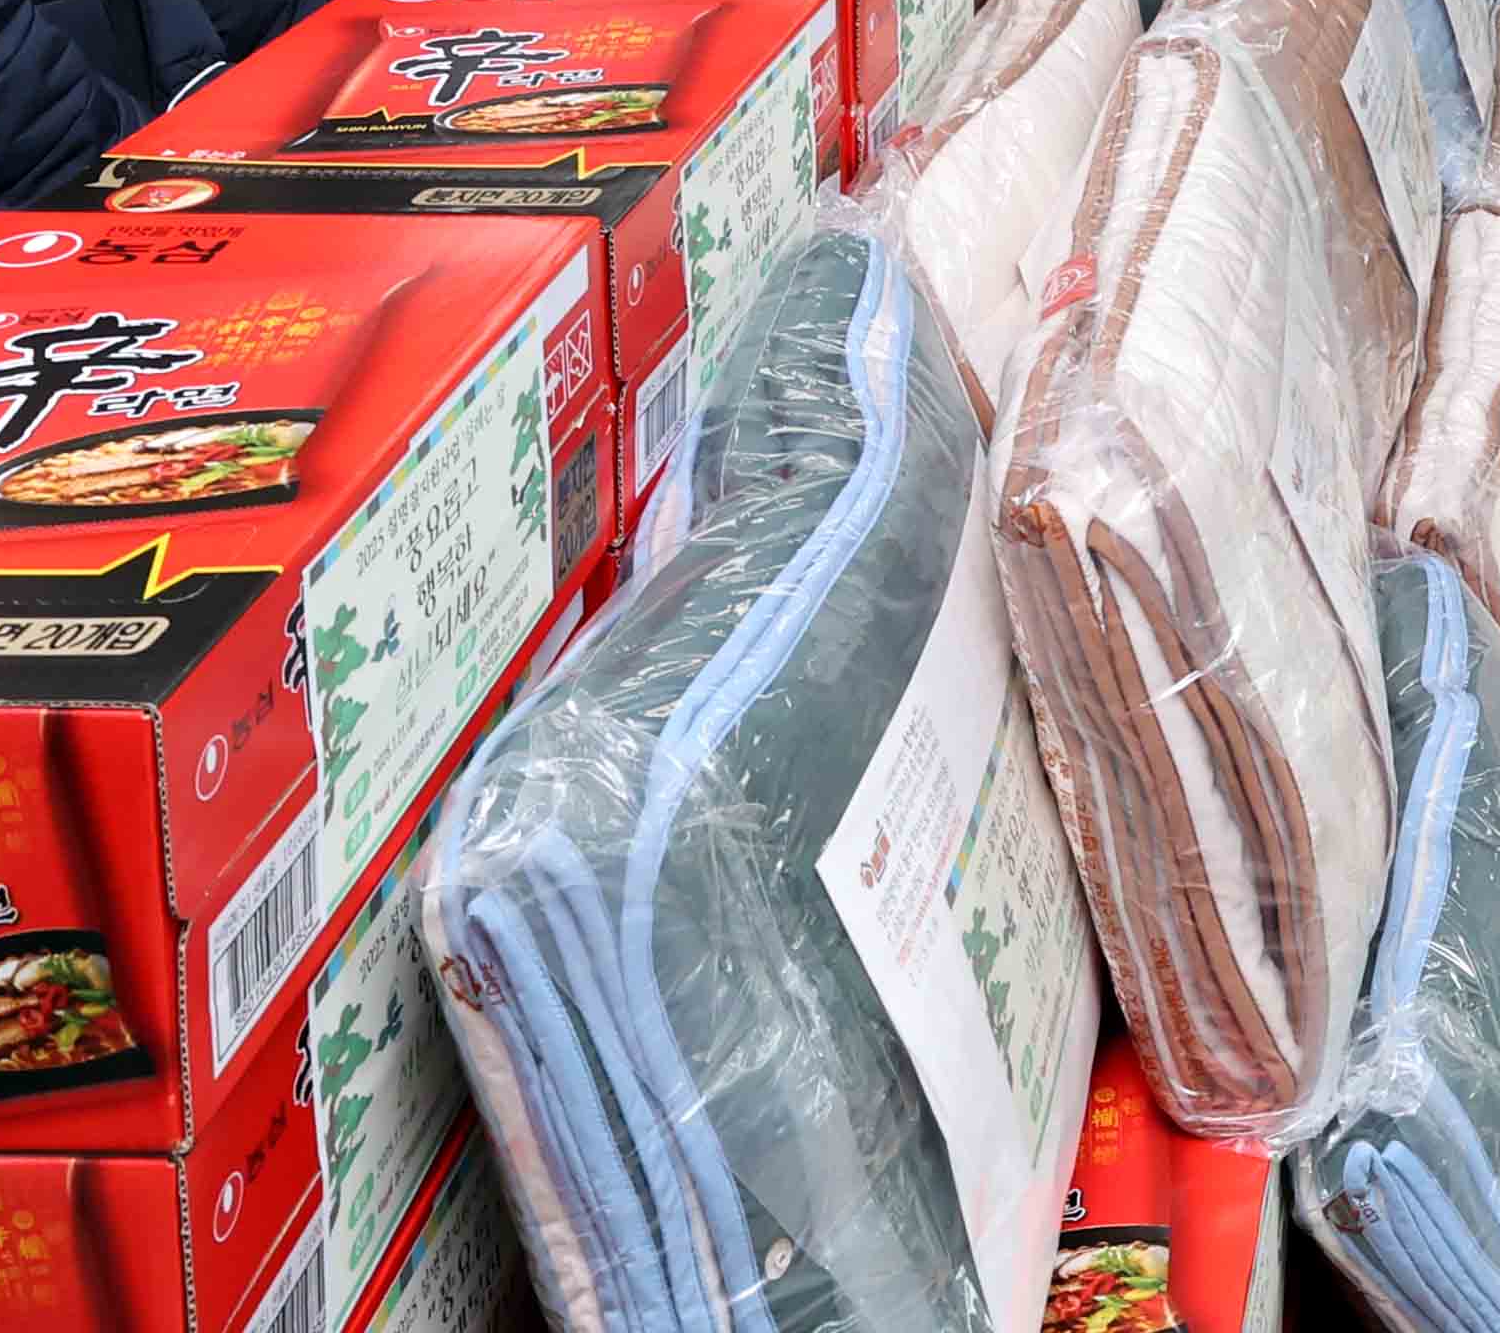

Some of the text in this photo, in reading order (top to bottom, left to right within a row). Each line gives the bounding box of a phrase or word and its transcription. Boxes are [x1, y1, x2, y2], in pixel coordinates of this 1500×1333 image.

[390, 29, 570, 105] 辛
[510, 188, 595, 206] 20개입
[77, 237, 233, 267] 농심
[86, 380, 243, 419] 라면
[394, 455, 480, 575] "풍요롭고
[415, 521, 473, 619] 행복한
[25, 619, 157, 652] 20개입
